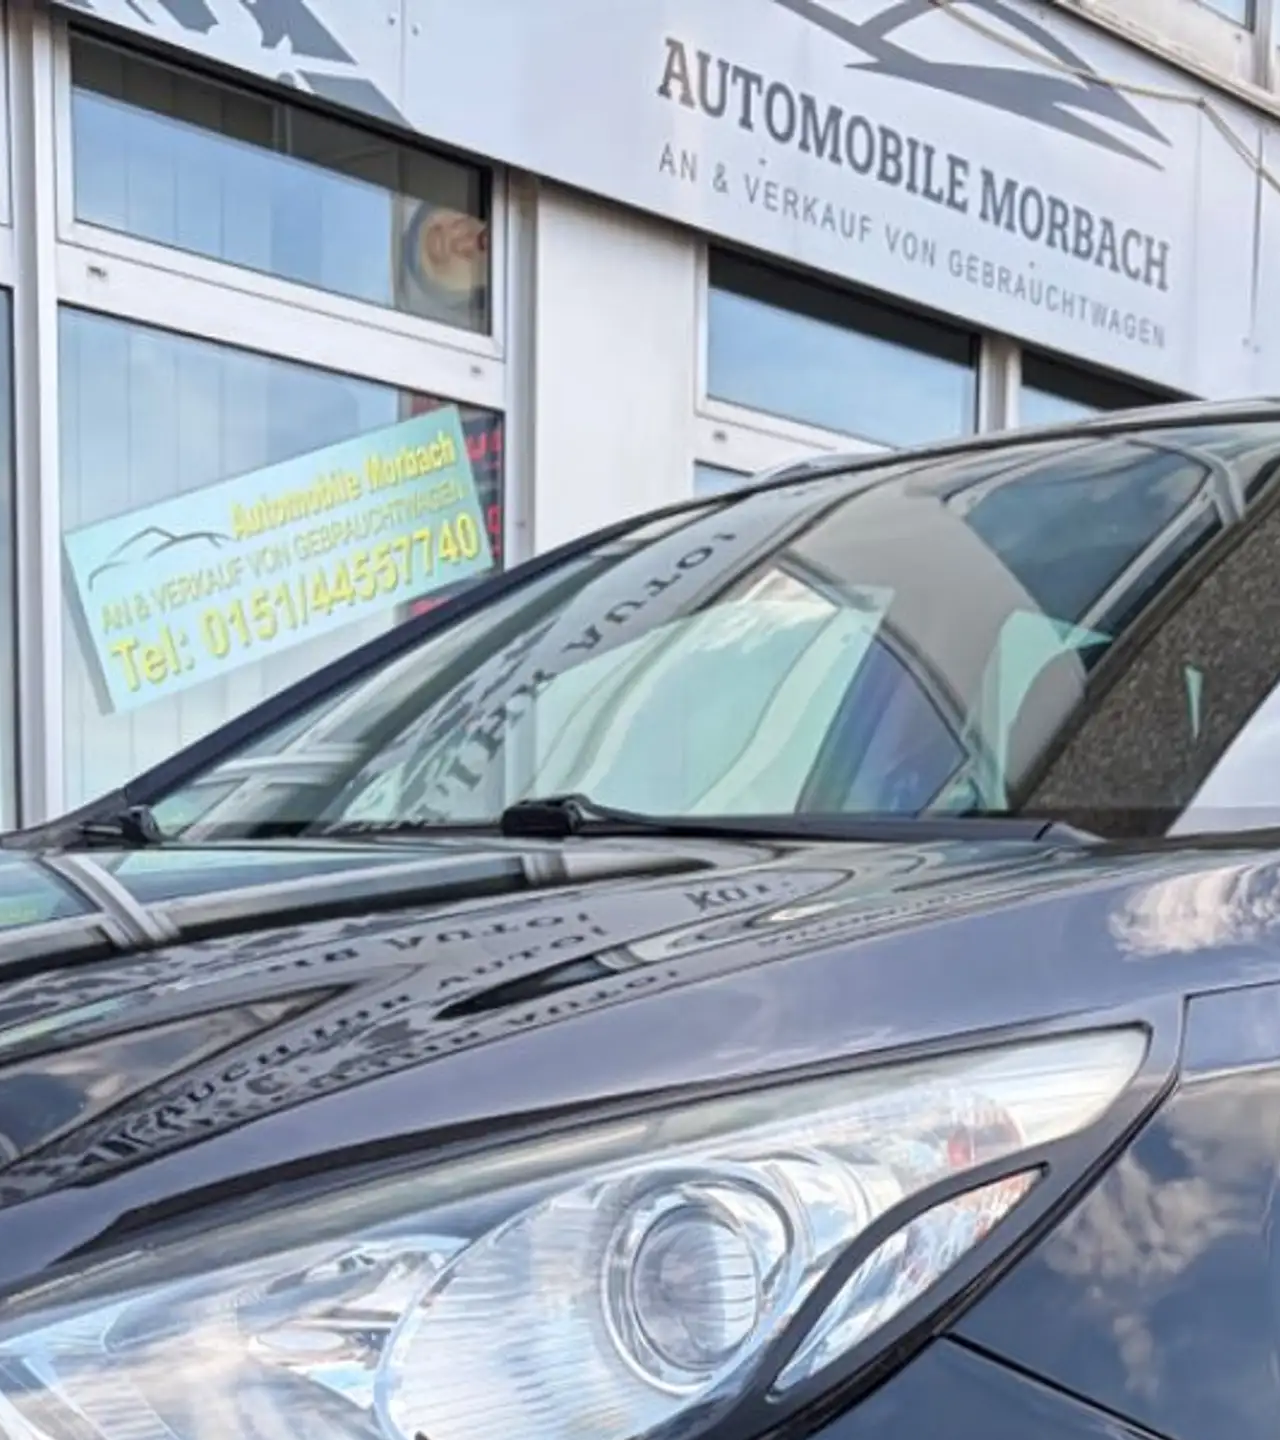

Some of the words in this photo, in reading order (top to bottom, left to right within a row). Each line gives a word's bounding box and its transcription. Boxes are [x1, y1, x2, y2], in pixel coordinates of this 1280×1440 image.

[656, 37, 969, 213] AUTOMOBILE
[978, 166, 1170, 292] MORBACH
[658, 143, 698, 183] AN
[712, 162, 730, 194] &
[744, 172, 873, 244] VERKAUF
[884, 224, 937, 269] VON
[948, 248, 1167, 350] GEBRAUCHTWAGEN
[233, 473, 361, 540] Automobile
[361, 430, 456, 494] Morbach
[109, 624, 198, 693] Tel:
[200, 510, 481, 661] 0151/44557740
